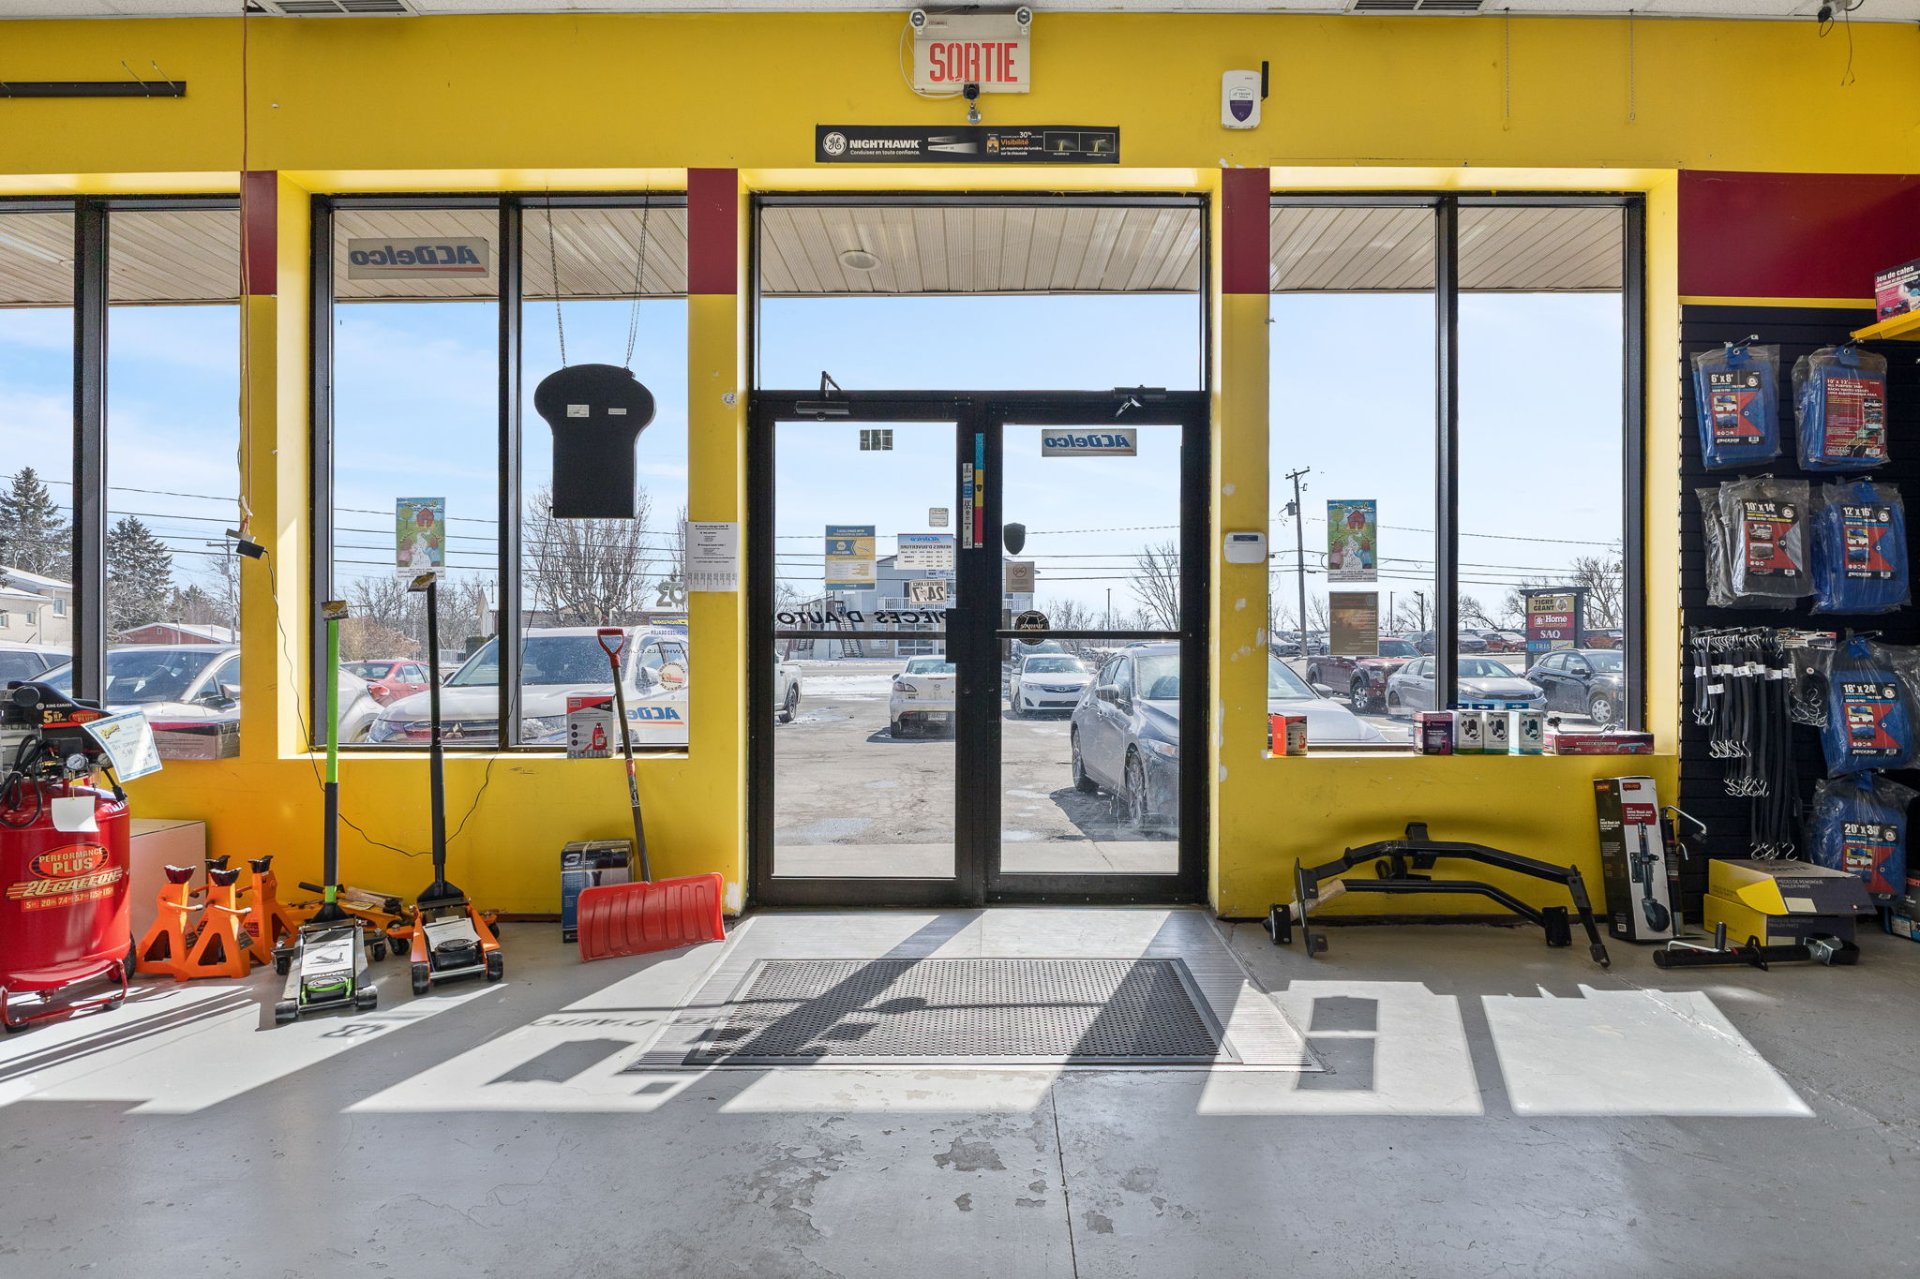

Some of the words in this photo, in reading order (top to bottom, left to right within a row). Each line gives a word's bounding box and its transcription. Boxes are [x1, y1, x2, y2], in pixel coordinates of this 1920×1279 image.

[930, 42, 1018, 82] SORTIE
[850, 140, 919, 148] NIGHTHAWK
[1876, 274, 1887, 283] Jeu
[1540, 630, 1560, 639] SAQ
[43, 710, 53, 724] 5
[1844, 824, 1859, 833] 20'
[39, 848, 103, 863] PERFORMANCE
[564, 853, 580, 866] 3
[52, 858, 93, 875] PLUS
